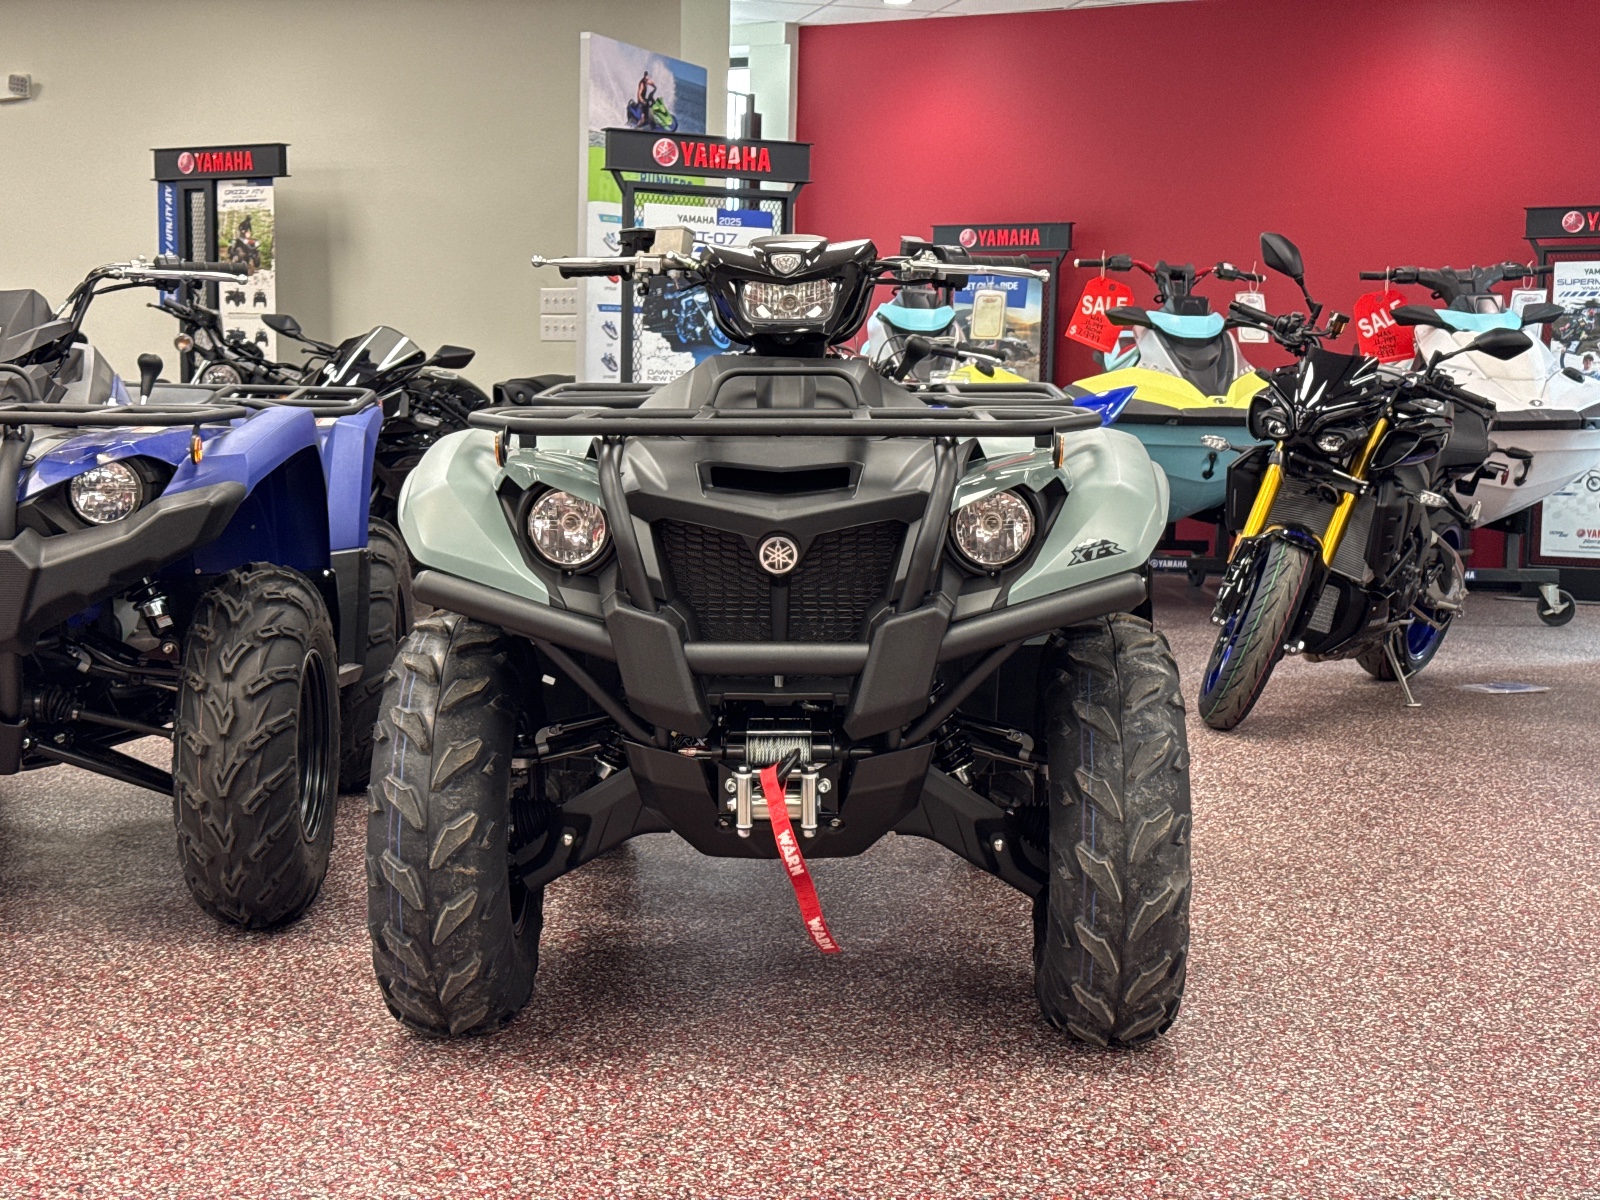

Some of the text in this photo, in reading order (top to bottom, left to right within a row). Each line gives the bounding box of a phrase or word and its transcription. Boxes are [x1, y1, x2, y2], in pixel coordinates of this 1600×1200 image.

[195, 151, 253, 172] YAMAHA
[680, 141, 771, 172] YAMAHA
[164, 184, 173, 206] ATV
[677, 214, 742, 227] YAMAHA 2025
[693, 230, 738, 245] T-07
[978, 228, 1041, 247] YAMAHA
[962, 281, 976, 291] ET
[1159, 559, 1188, 568] YAMAHA
[777, 829, 805, 877] WARN
[807, 916, 836, 950] WARN
